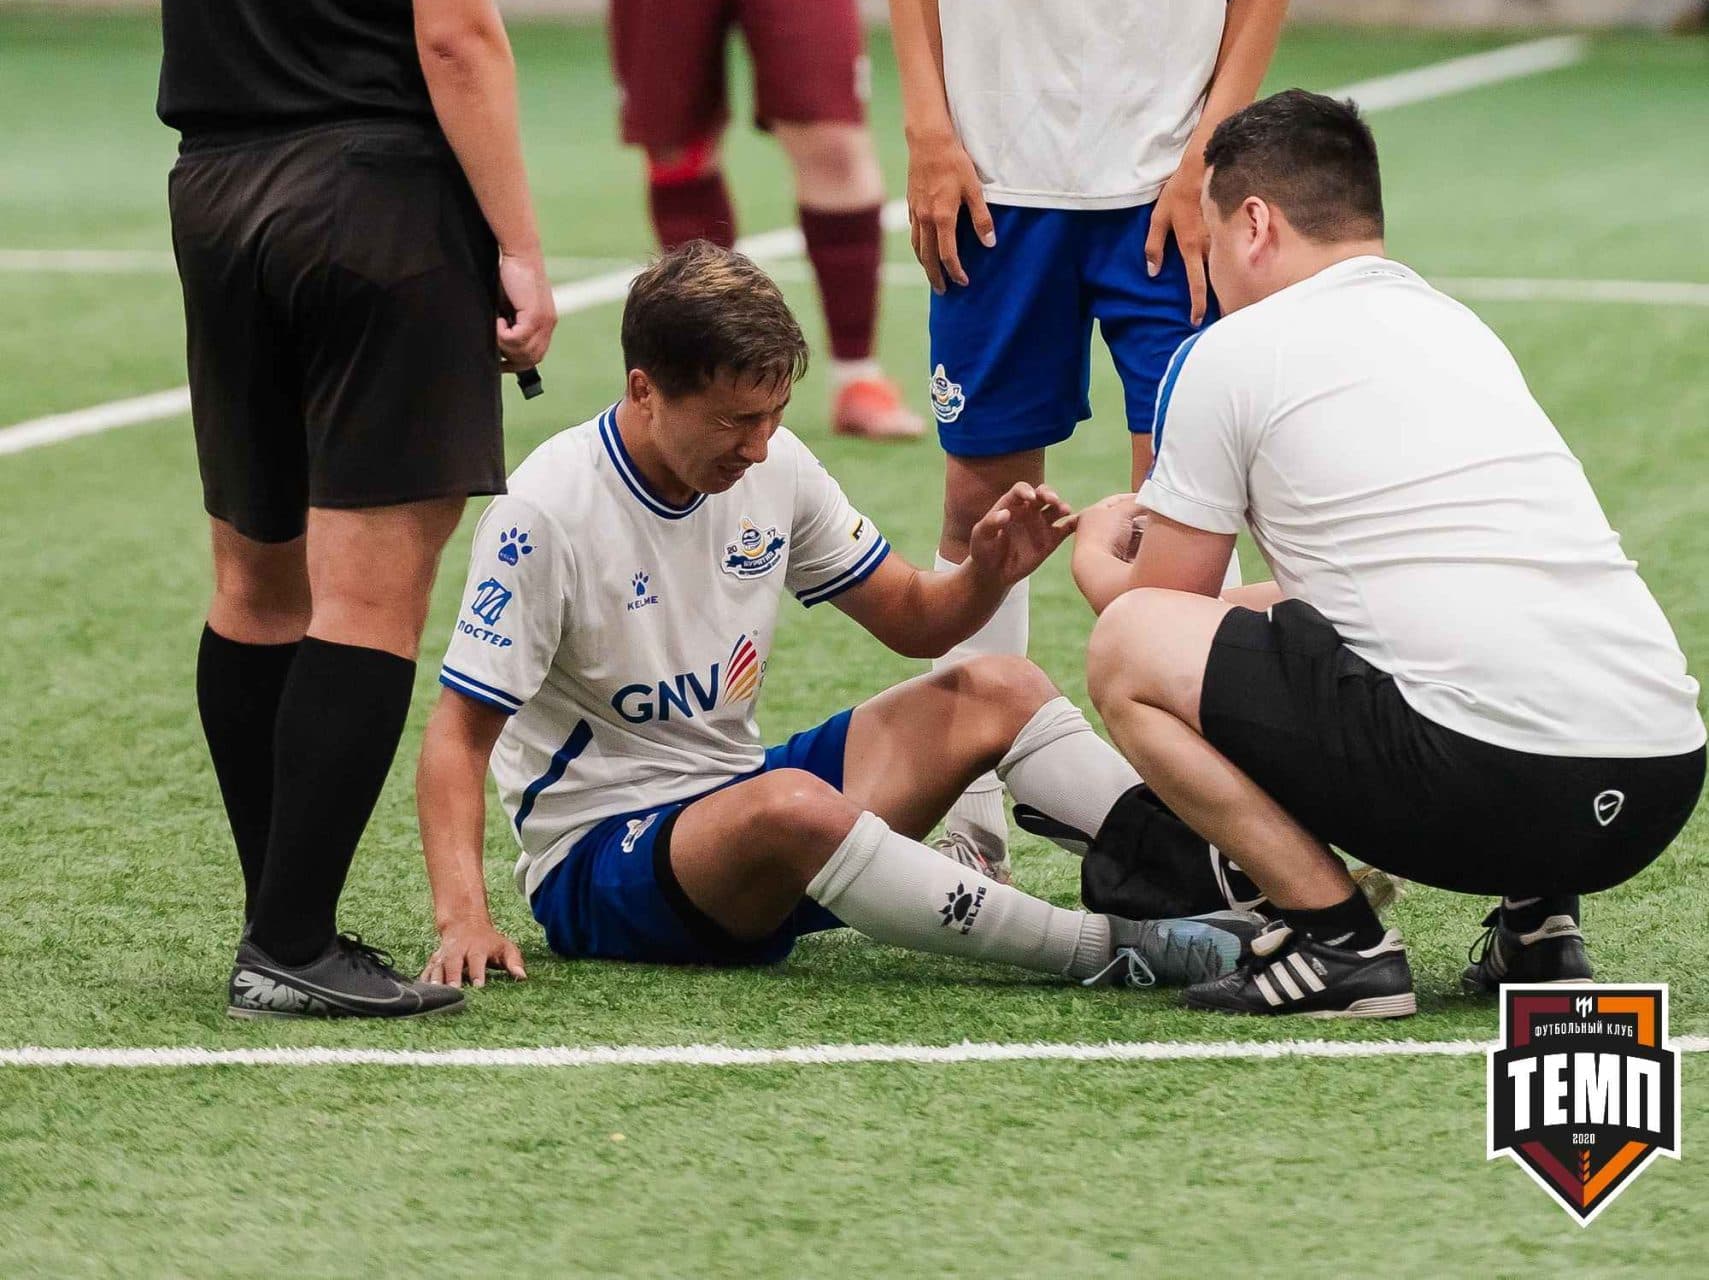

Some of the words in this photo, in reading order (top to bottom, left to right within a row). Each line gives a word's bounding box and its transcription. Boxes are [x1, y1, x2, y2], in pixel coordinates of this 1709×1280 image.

[727, 545, 738, 555] 20
[627, 596, 659, 611] KELME
[458, 620, 513, 648] ПОСТЕР
[611, 663, 720, 724] GNV
[960, 886, 987, 935] KELME
